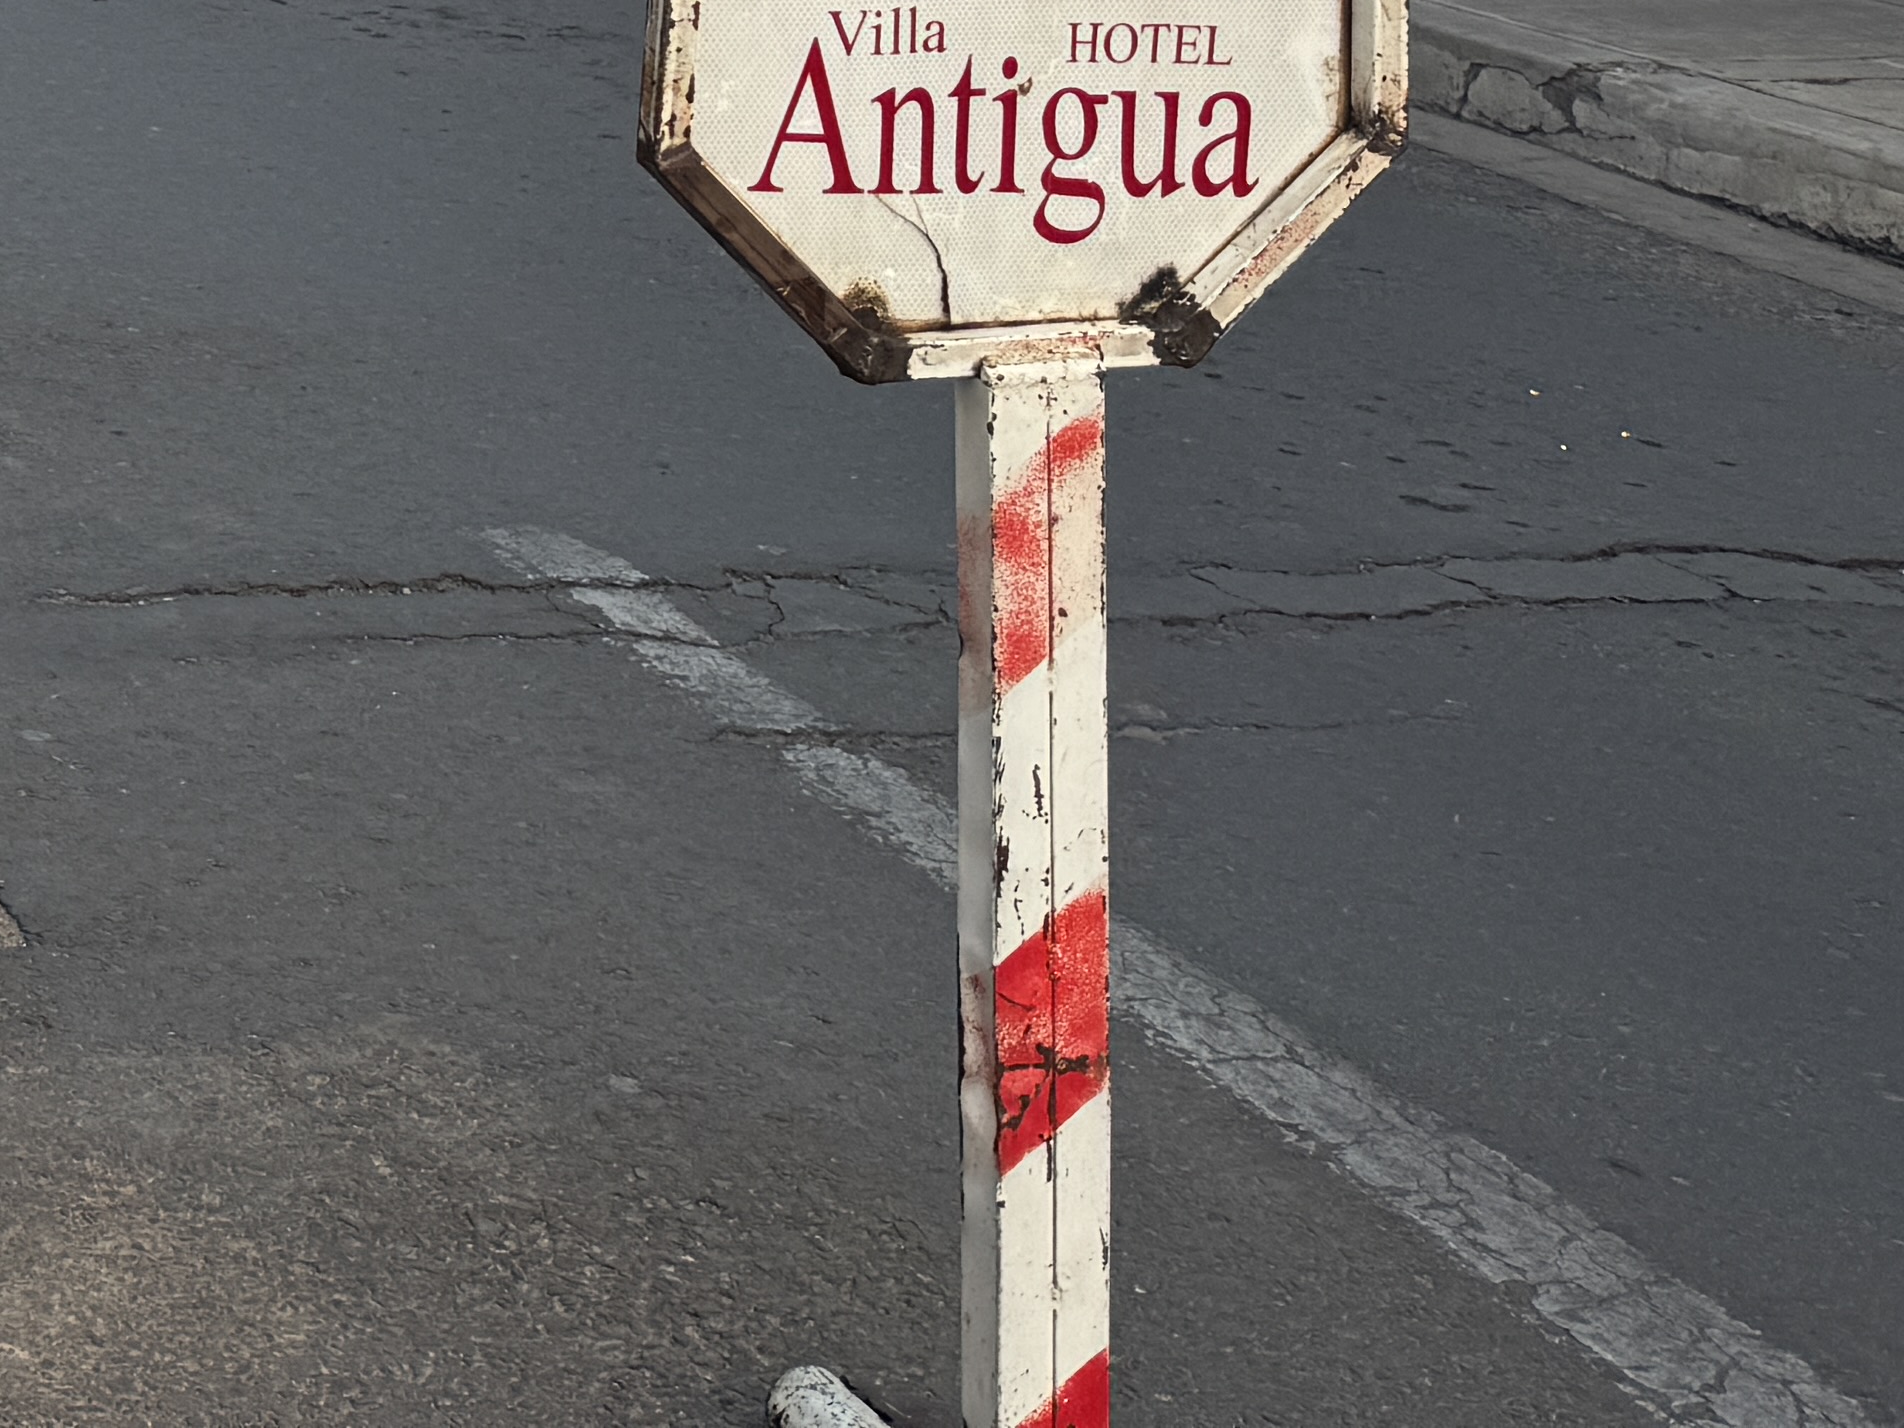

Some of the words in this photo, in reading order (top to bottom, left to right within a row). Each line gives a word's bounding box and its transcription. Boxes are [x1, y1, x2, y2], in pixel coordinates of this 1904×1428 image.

[827, 7, 948, 58] Villa
[1066, 21, 1234, 69] HOTEL
[747, 36, 1260, 245] Antigua
